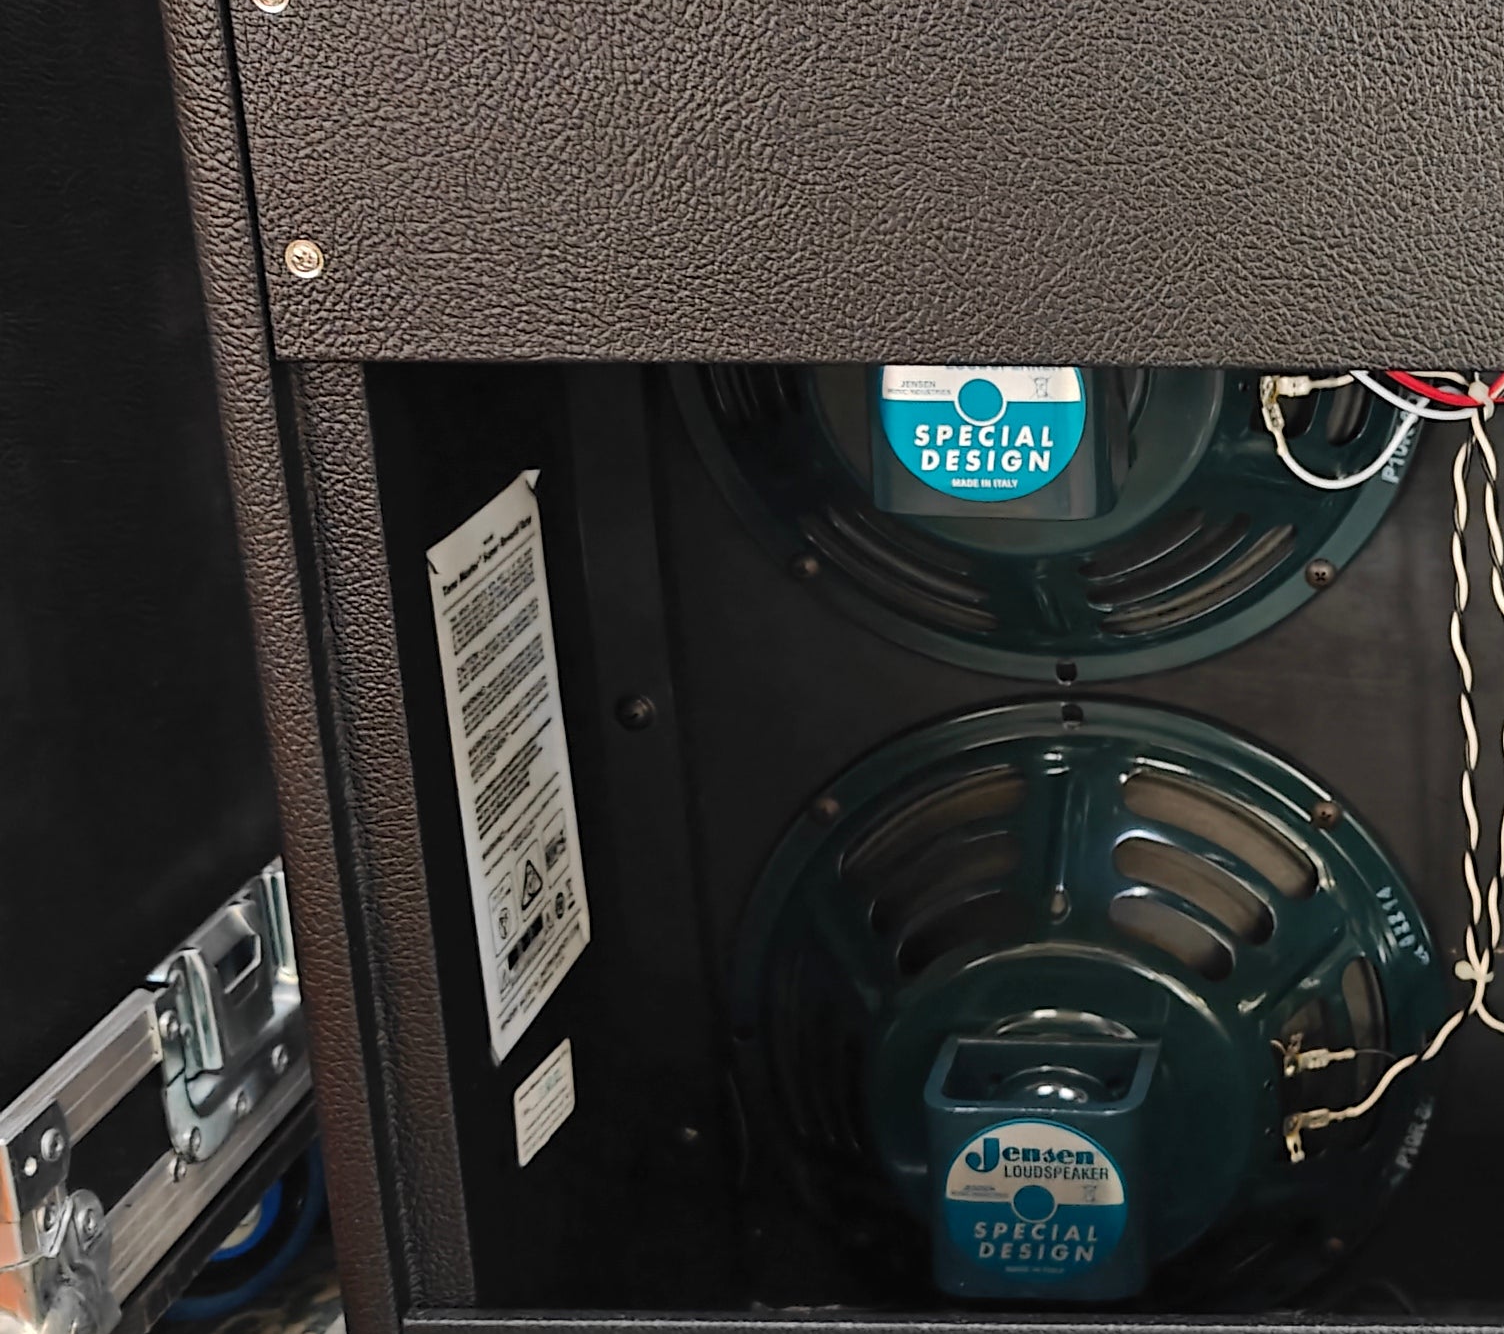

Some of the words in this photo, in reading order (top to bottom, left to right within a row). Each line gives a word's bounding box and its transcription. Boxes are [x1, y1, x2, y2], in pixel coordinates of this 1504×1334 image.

[914, 424, 1054, 448] SPECIAL
[921, 449, 1051, 472] DESIGN
[952, 478, 979, 488] MADE
[981, 479, 992, 488] IN
[993, 479, 1019, 489] ITALY
[965, 1137, 1095, 1173] Jensen
[1004, 1165, 1109, 1180] LOUDSPEAKER
[974, 1222, 1098, 1241] SPECIAL
[978, 1242, 1094, 1262] DESIGN
